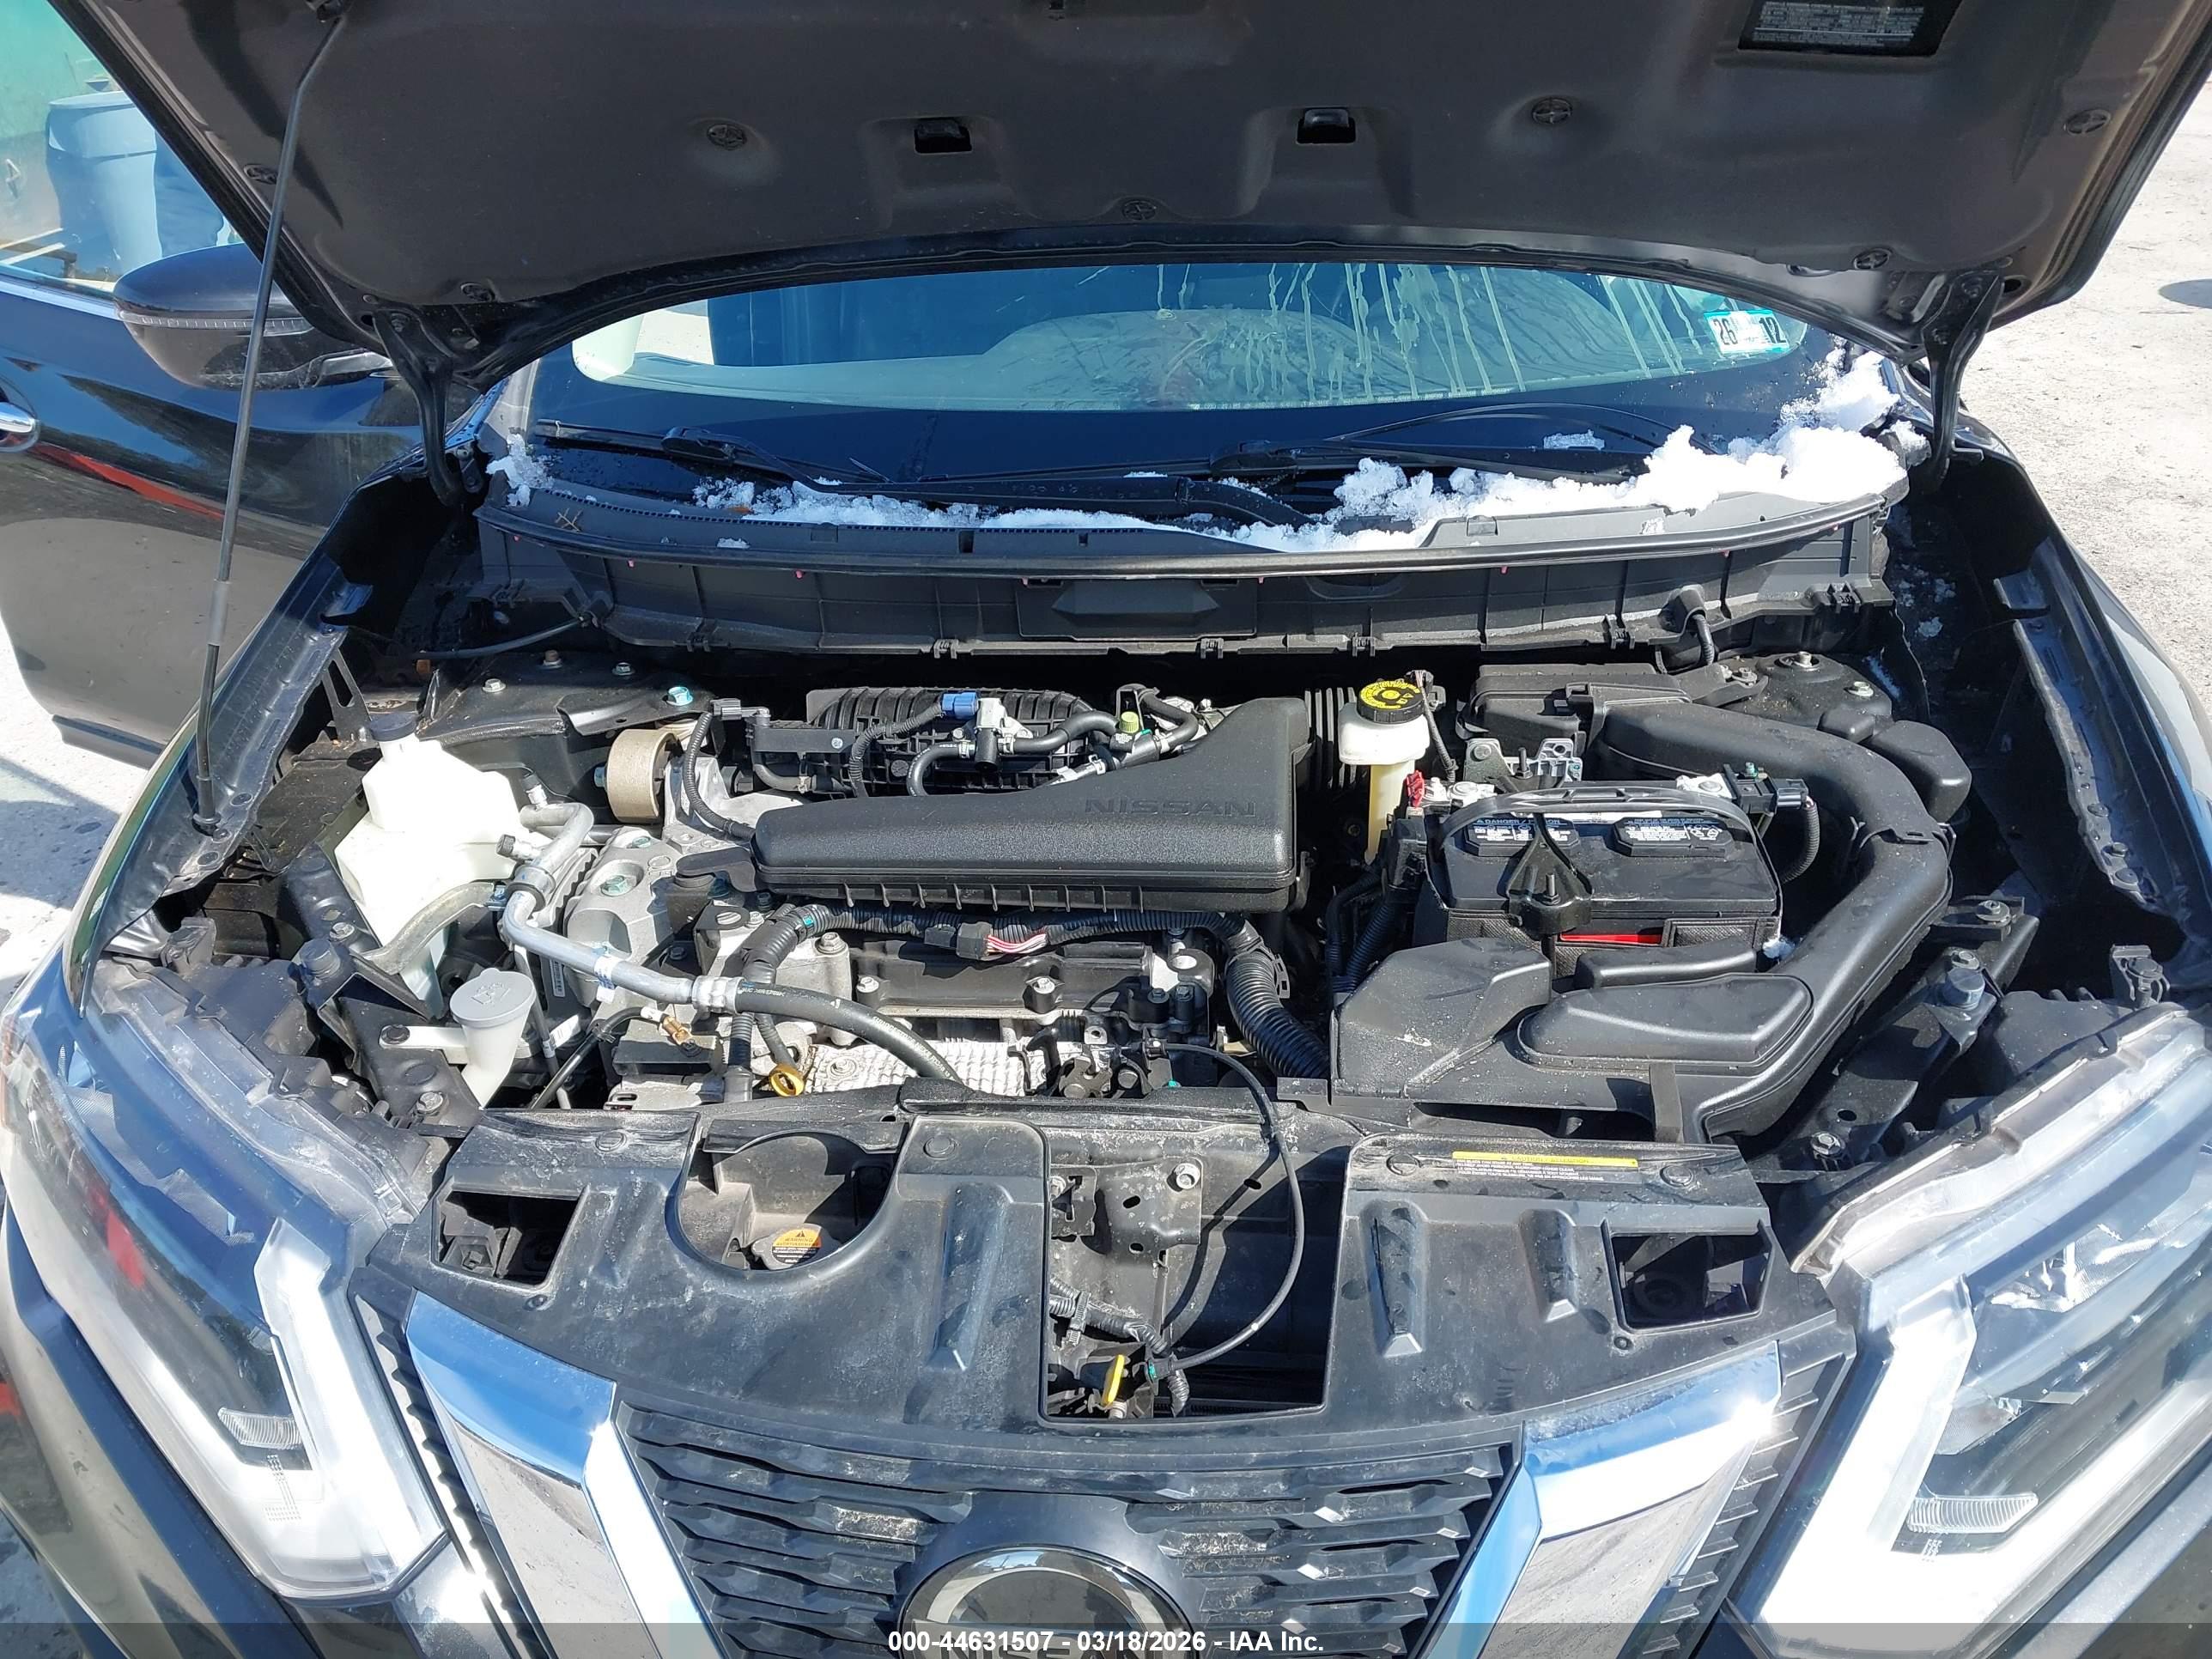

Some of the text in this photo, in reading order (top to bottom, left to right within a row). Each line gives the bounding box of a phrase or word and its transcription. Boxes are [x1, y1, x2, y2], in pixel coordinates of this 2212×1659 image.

[1713, 318, 1739, 345] 26
[1759, 317, 1787, 344] 12
[1085, 796, 1257, 818] NISSAN
